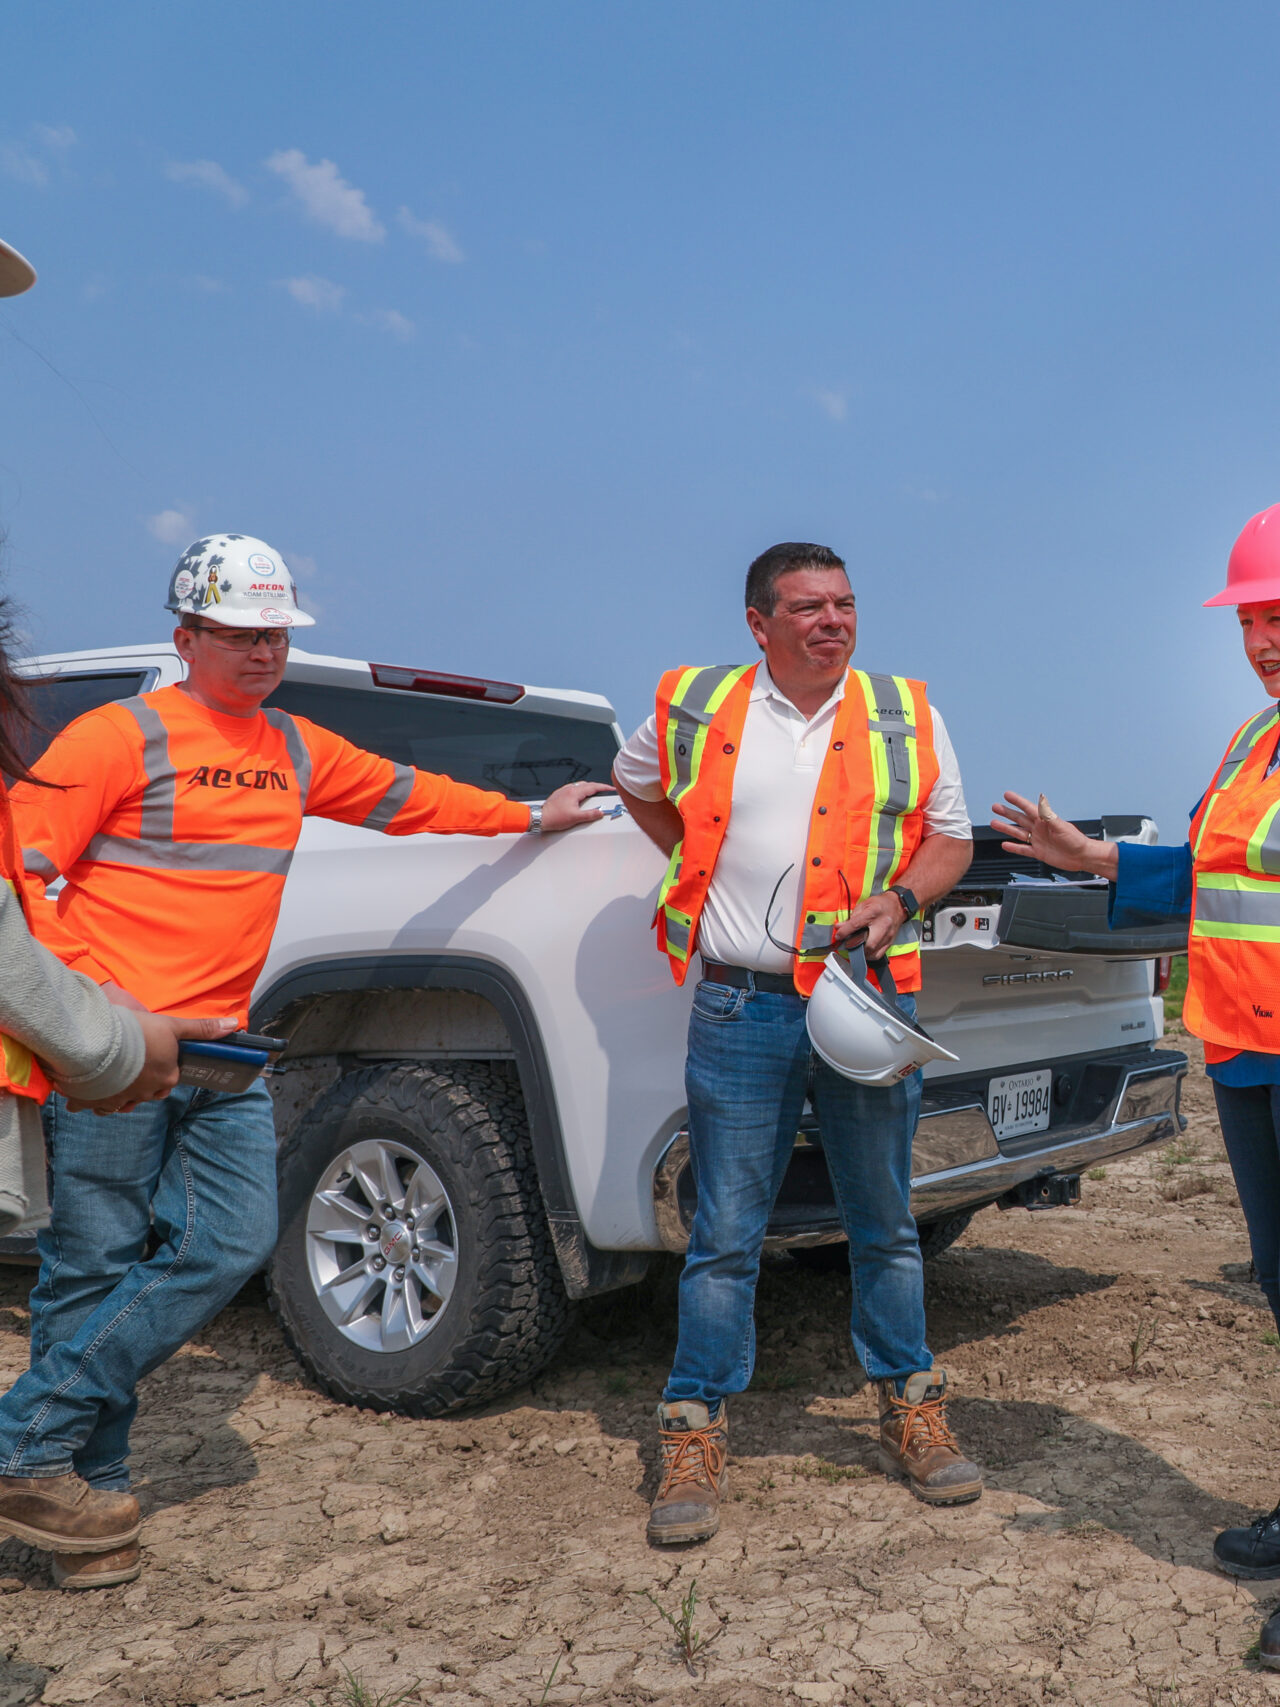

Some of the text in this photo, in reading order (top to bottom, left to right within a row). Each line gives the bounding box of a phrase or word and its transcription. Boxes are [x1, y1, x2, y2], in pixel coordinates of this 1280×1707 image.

[982, 969, 1074, 987] SIERRA
[1008, 1079, 1034, 1091] ONTARIO
[1013, 1086, 1049, 1121] 19984
[384, 1231, 403, 1256] GMC
